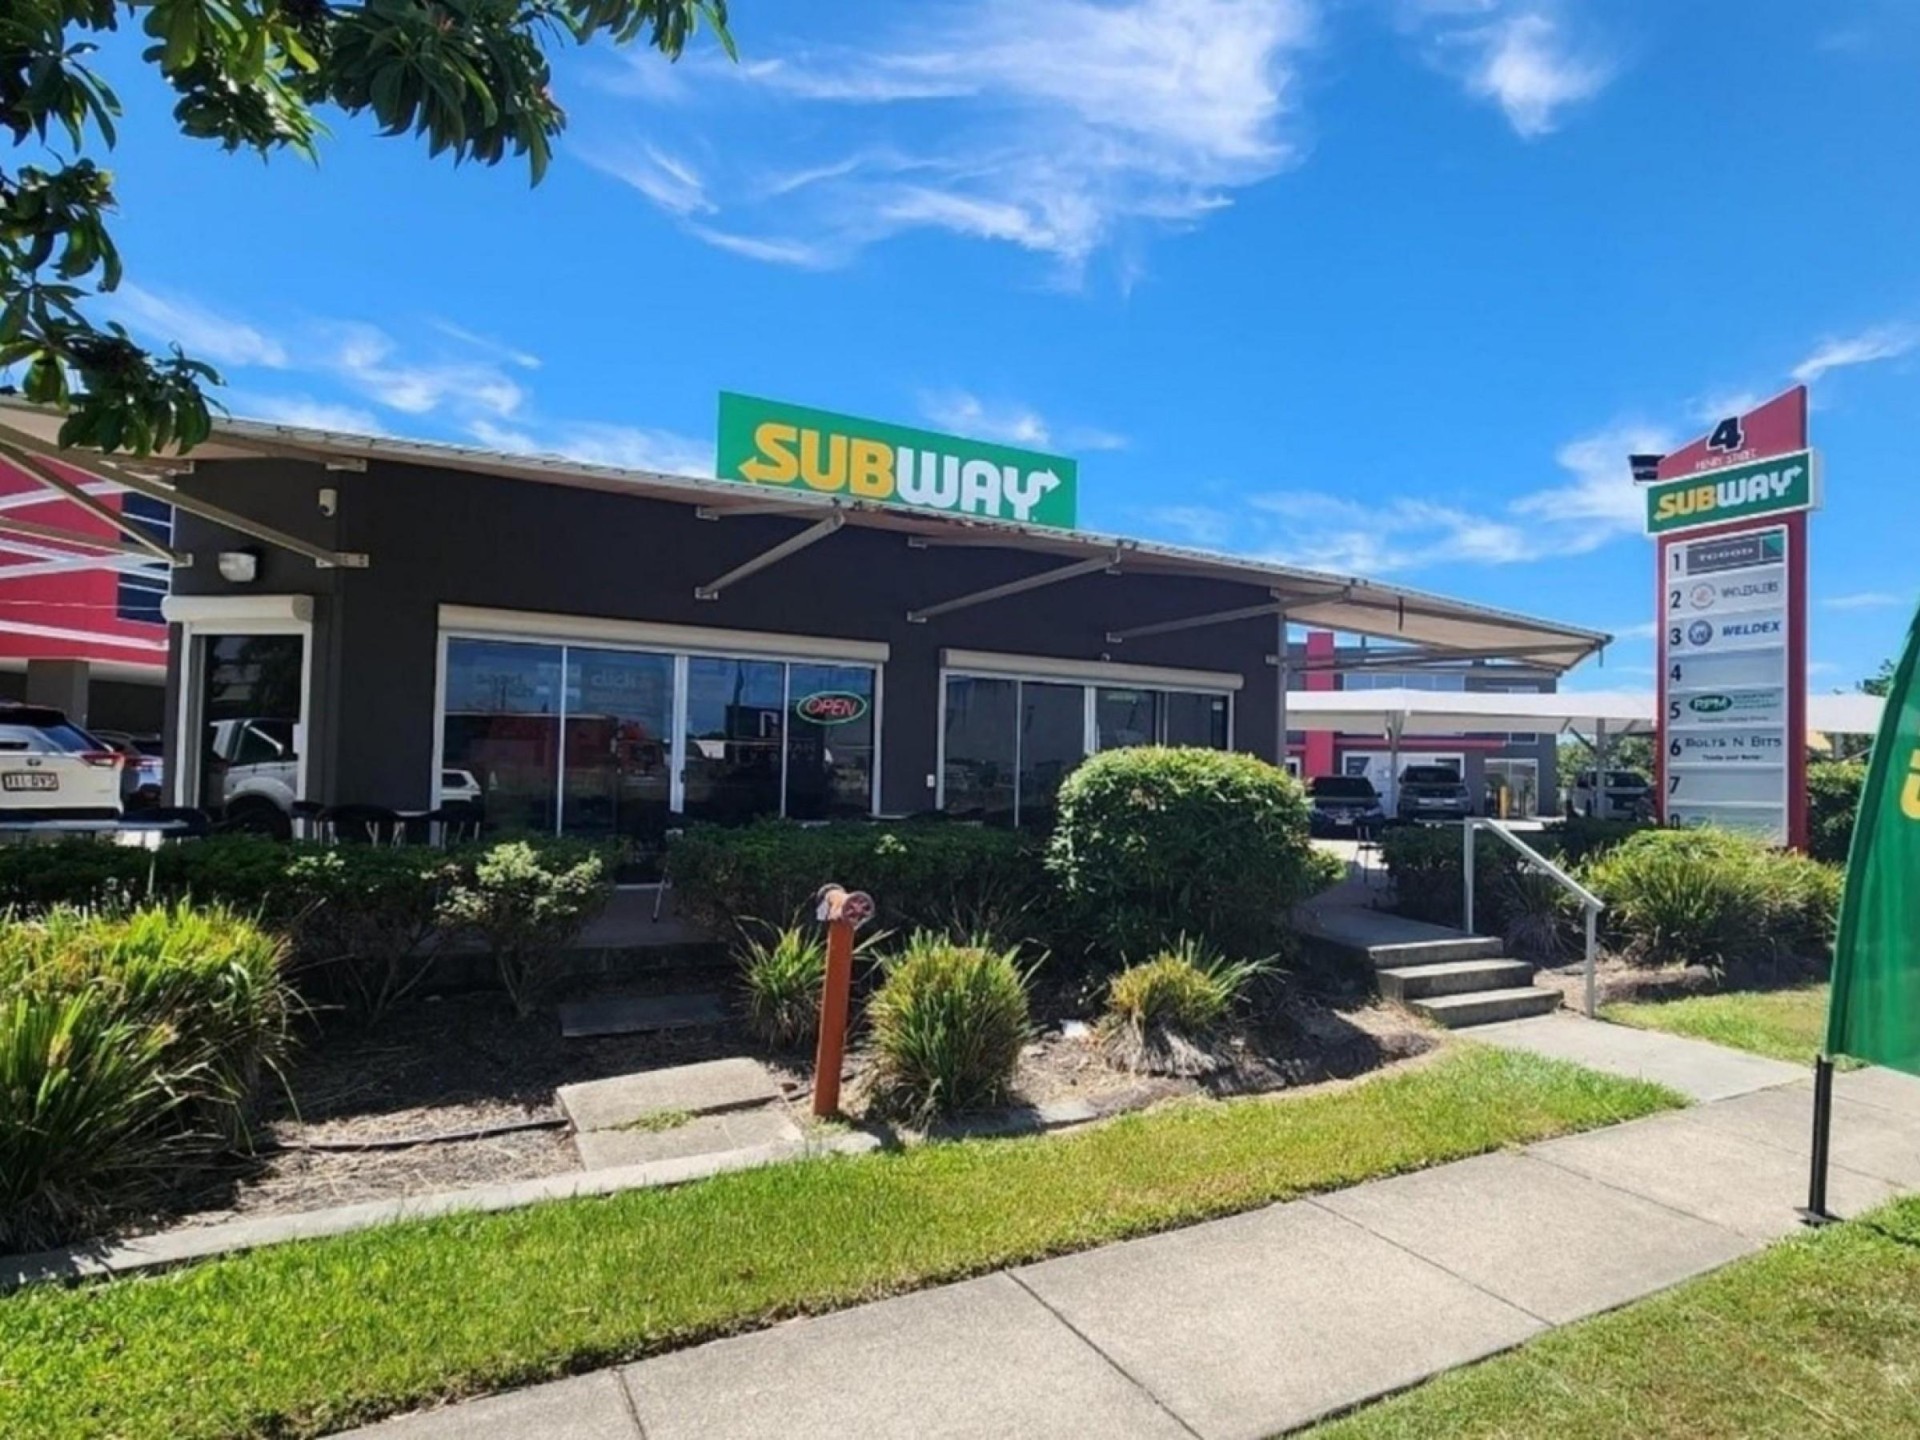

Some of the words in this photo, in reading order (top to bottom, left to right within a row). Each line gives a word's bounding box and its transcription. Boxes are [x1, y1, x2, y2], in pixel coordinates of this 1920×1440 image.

[1707, 416, 1744, 453] 4
[738, 422, 1061, 521] SUBWAY
[1654, 465, 1803, 521] SUBWAY
[1673, 553, 1680, 571] 1
[1670, 591, 1681, 609] 2
[1670, 628, 1682, 646] 3
[1722, 620, 1781, 637] WELDEX
[1670, 664, 1682, 682] 4
[805, 698, 857, 716] OPEN
[1669, 702, 1681, 719] 5
[1669, 739, 1682, 756] 6
[1733, 737, 1744, 747] N
[1751, 736, 1782, 747] BITS
[1669, 776, 1681, 794] 7
